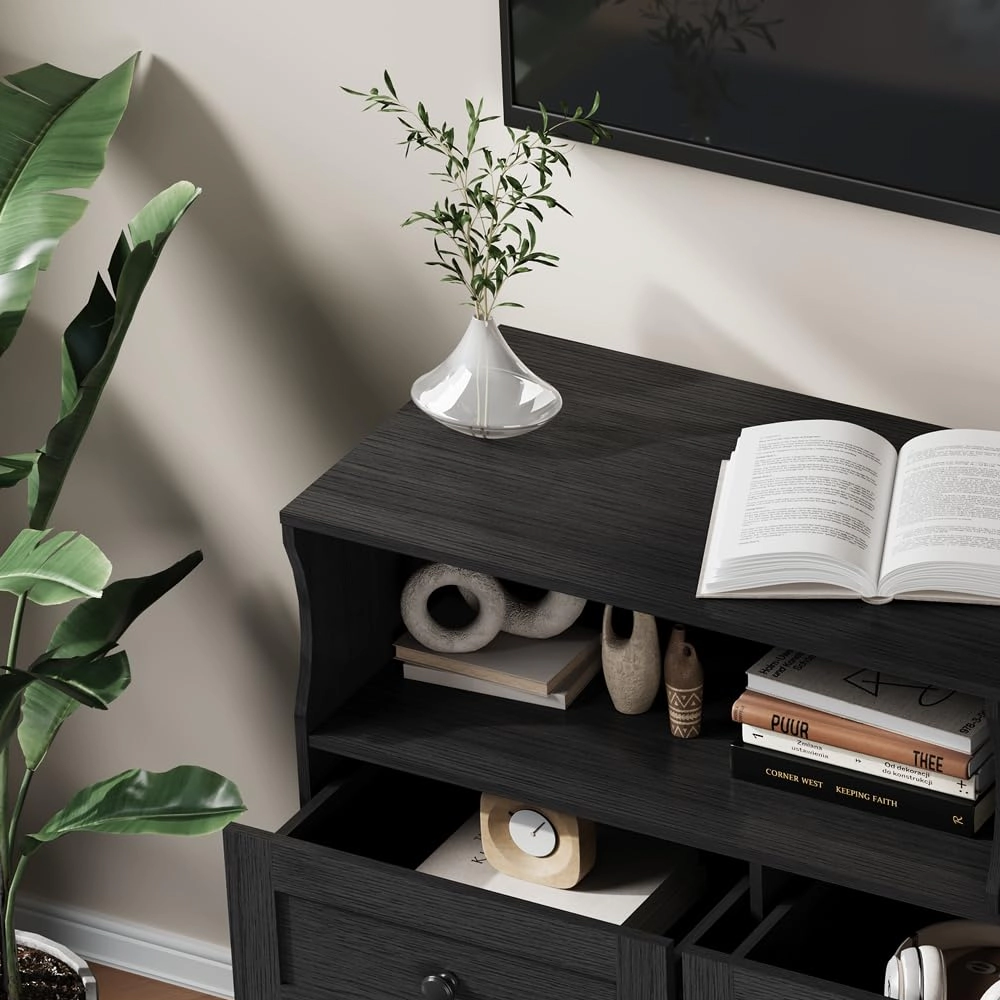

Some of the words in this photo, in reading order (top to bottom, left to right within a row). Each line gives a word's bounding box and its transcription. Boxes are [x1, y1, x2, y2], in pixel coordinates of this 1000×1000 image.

[771, 714, 809, 739] PUUR
[912, 750, 944, 773] THEE
[884, 761, 896, 770] Od
[896, 764, 931, 779] dekoracji
[892, 771, 934, 786] konstrukcji
[765, 768, 800, 784] CORNER
[800, 776, 824, 789] WEST
[835, 786, 871, 801] KEEPING
[872, 795, 898, 808] FAITH
